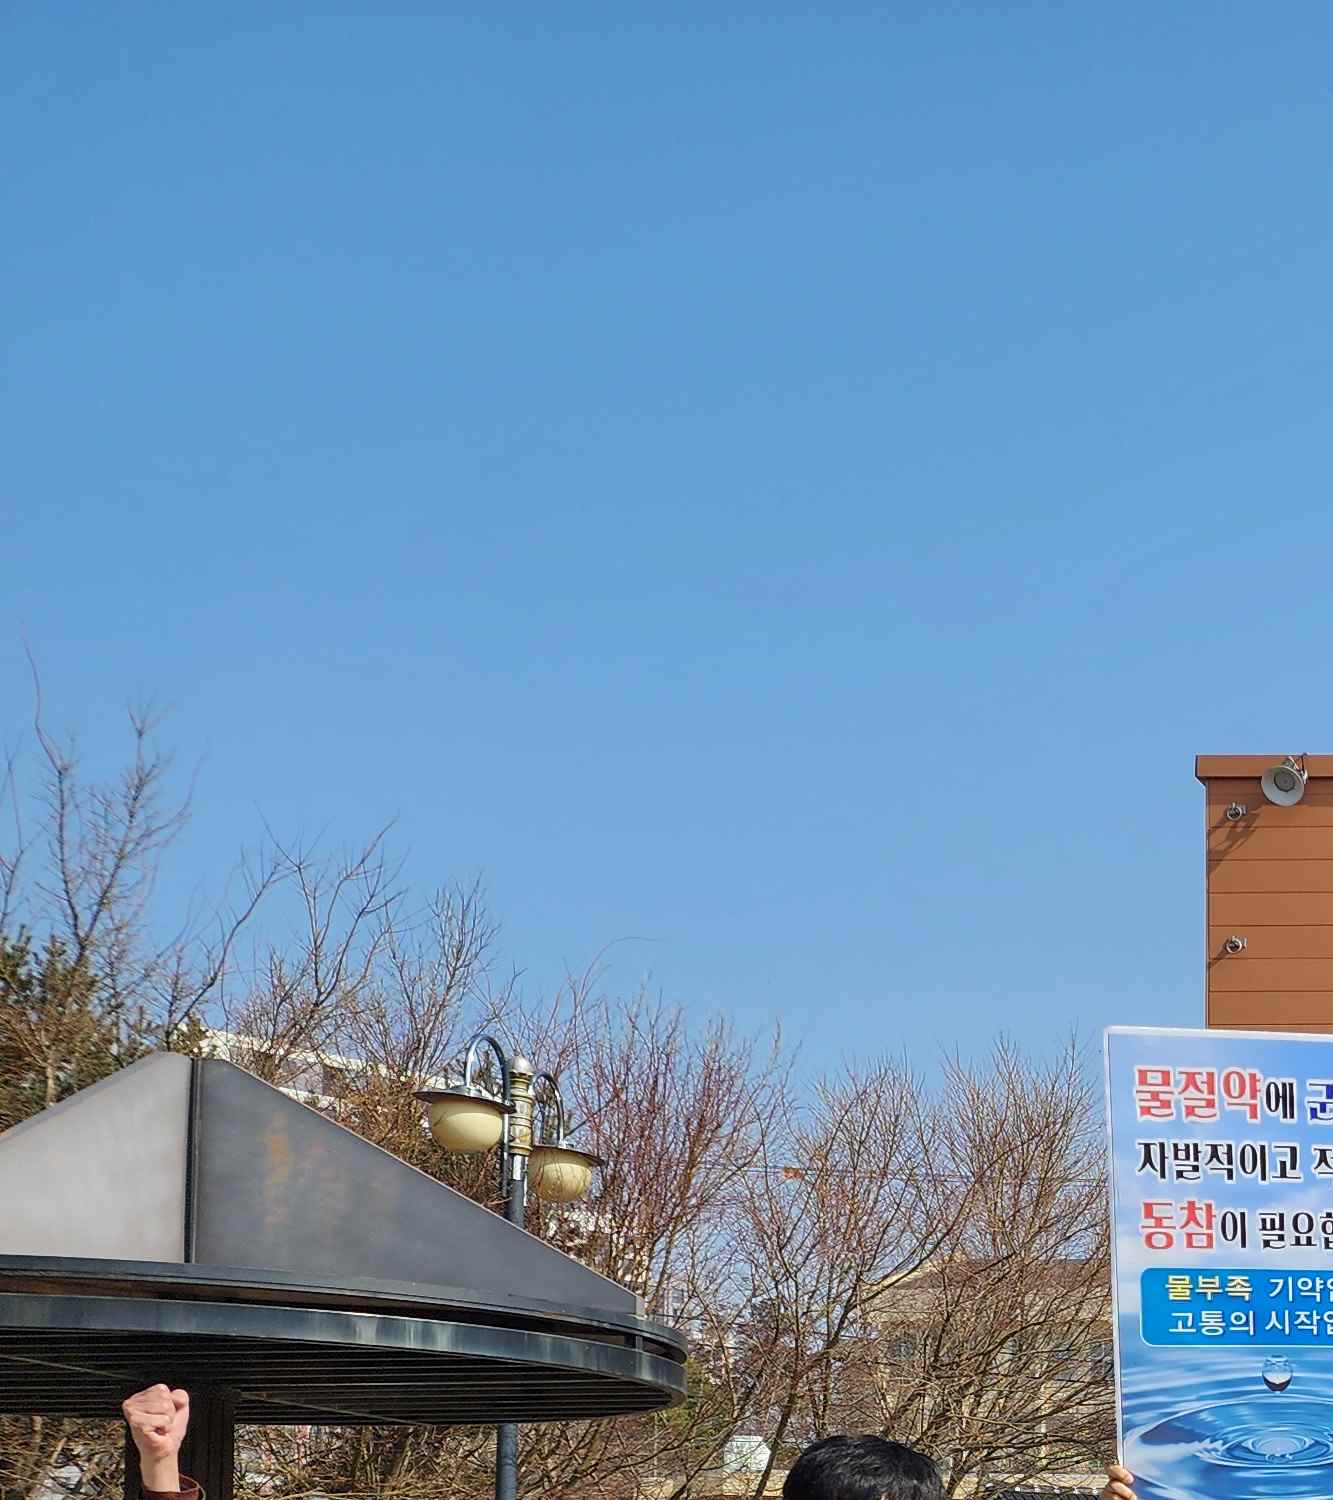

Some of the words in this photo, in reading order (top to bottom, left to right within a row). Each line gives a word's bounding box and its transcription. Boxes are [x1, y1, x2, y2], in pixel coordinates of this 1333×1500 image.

[1135, 1067, 1296, 1122] 물절약에
[1137, 1142, 1302, 1183] 자발적이고
[1140, 1201, 1248, 1250] 동참이
[1165, 1275, 1254, 1302] 물부족
[1168, 1311, 1256, 1336] 고통의
